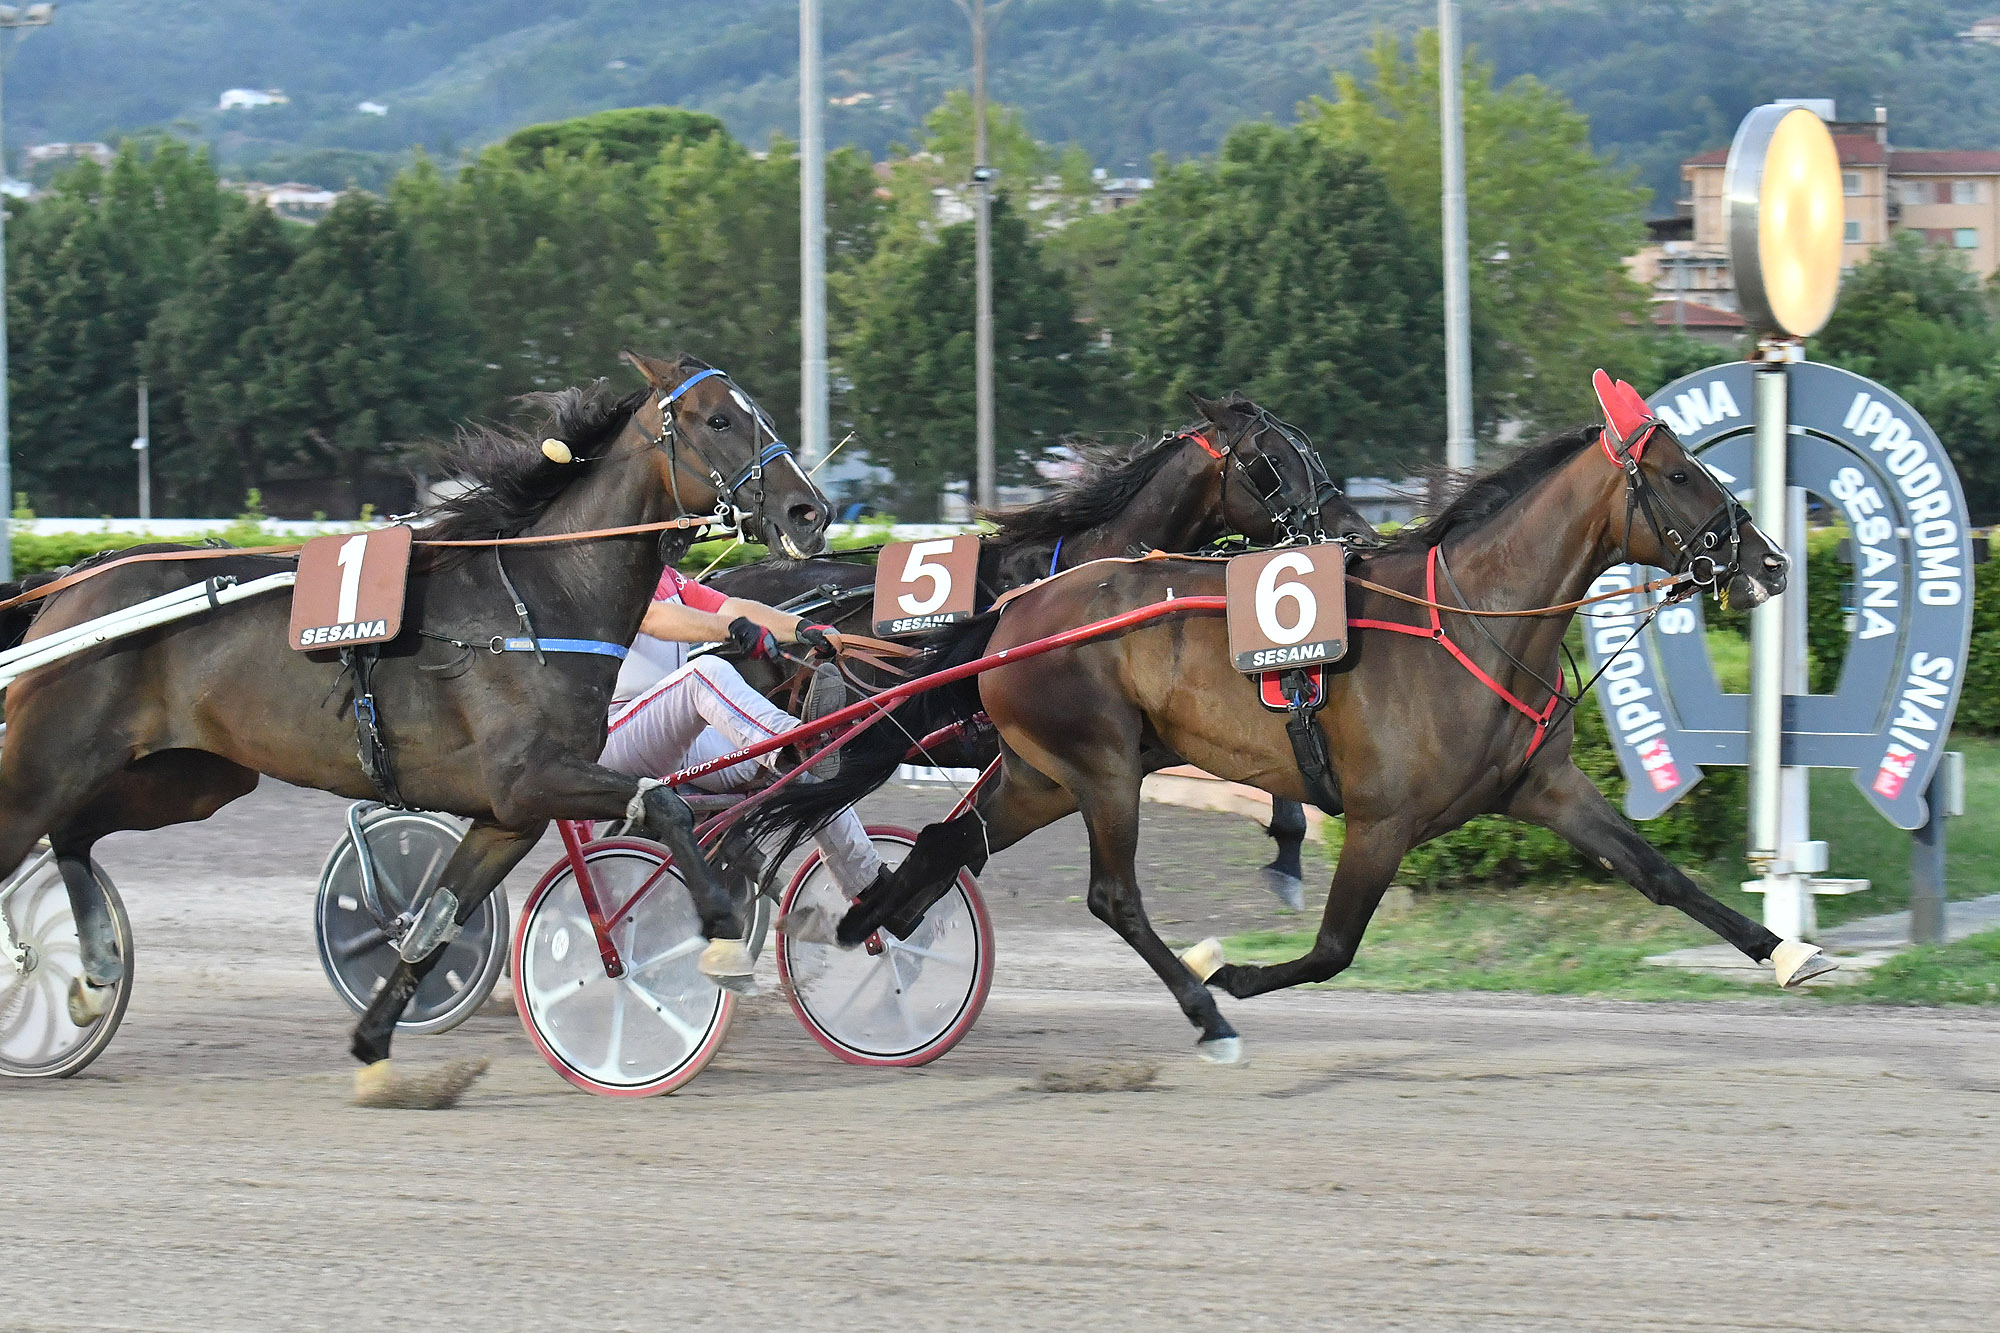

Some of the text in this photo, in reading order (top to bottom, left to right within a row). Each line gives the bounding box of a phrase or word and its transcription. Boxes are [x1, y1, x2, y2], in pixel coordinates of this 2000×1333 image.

[1654, 380, 1741, 438] ANA
[337, 534, 368, 624] 1
[897, 539, 954, 616] 5
[1829, 467, 1899, 640] SESANA
[1842, 392, 1962, 751] IPPODROMO SNAI
[300, 620, 386, 645] SESANA
[891, 613, 954, 632] SESANA
[1255, 551, 1317, 645] 6
[1252, 643, 1326, 666] SESANA
[1587, 563, 1667, 745] IPPODRO
